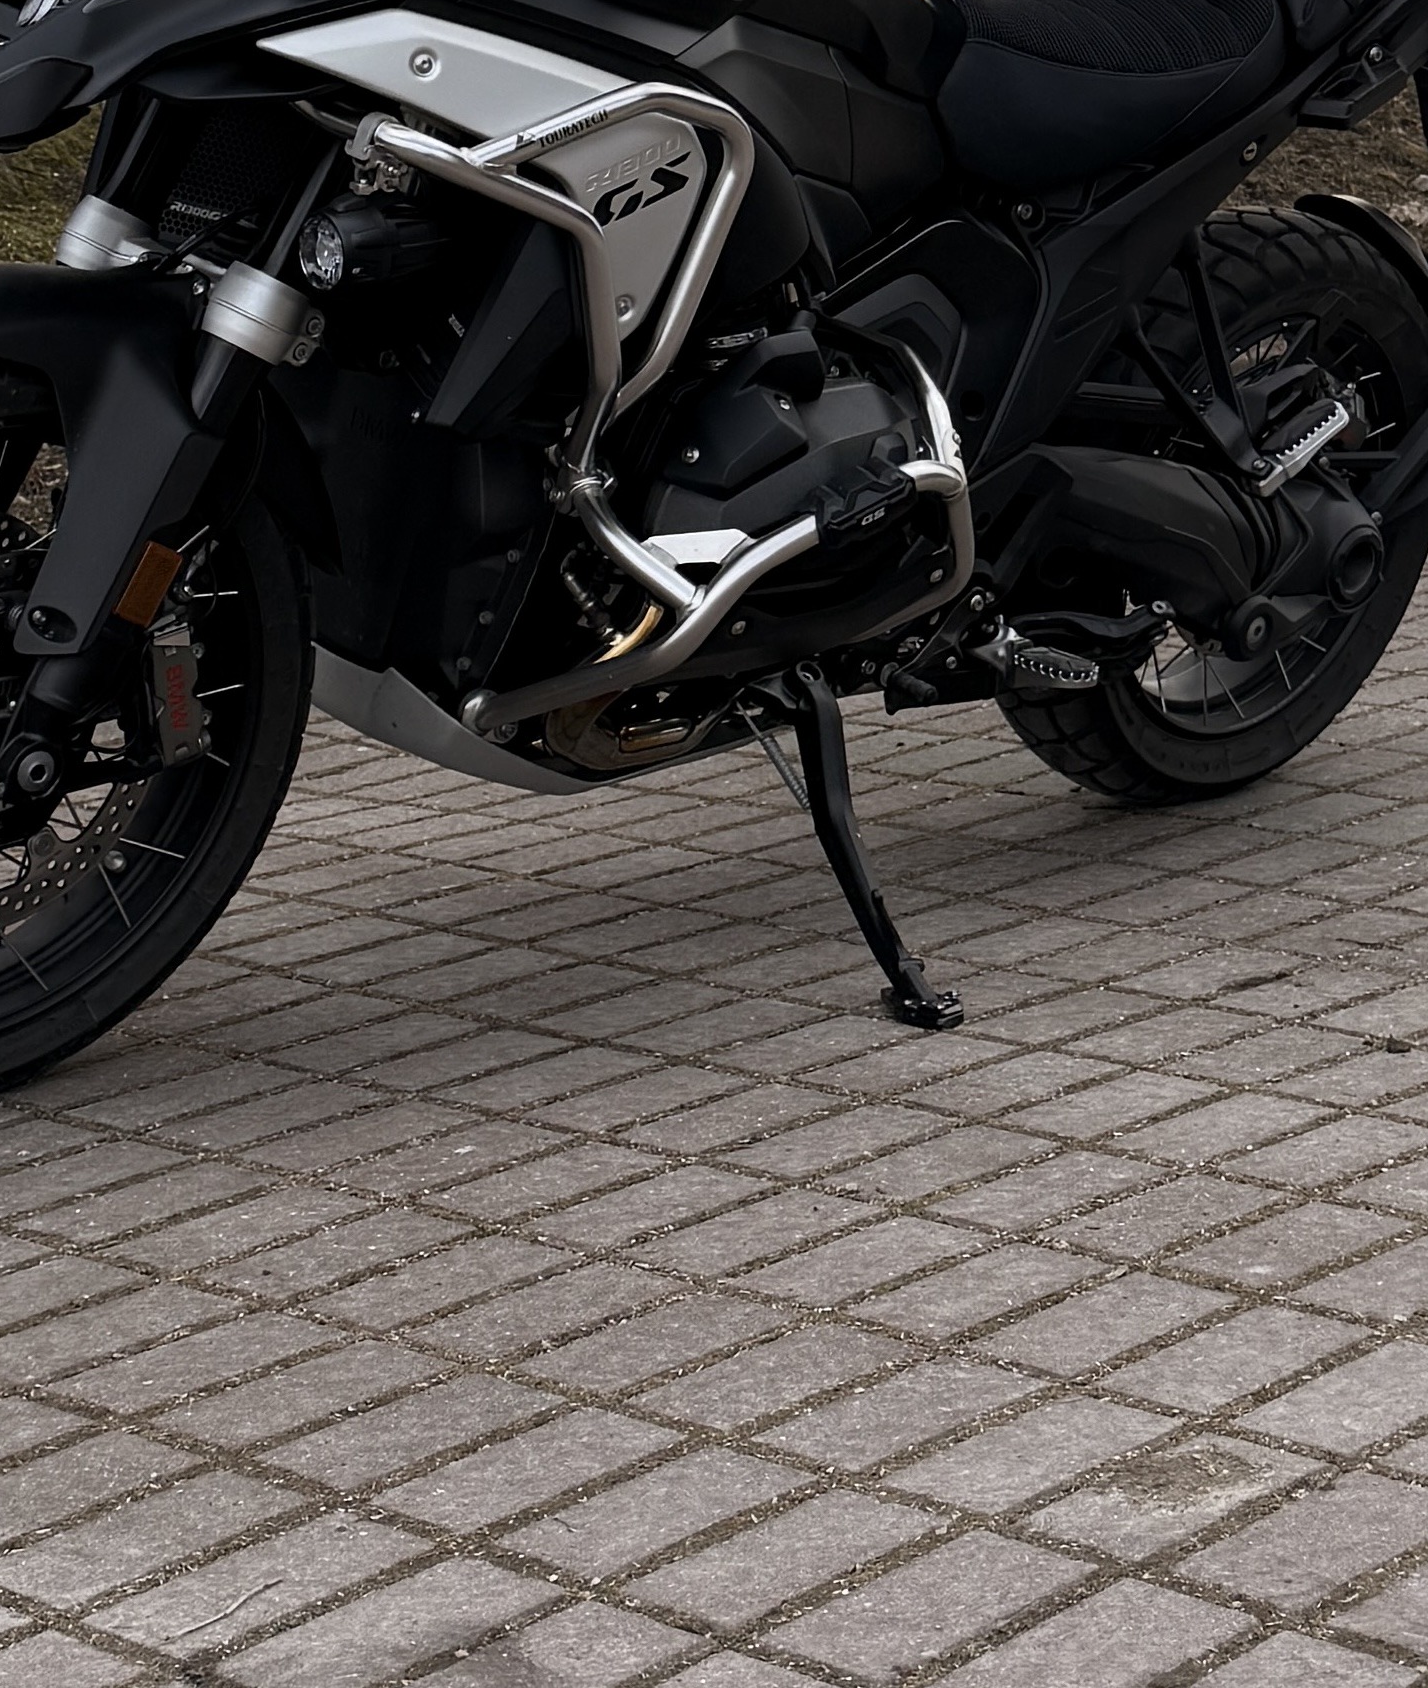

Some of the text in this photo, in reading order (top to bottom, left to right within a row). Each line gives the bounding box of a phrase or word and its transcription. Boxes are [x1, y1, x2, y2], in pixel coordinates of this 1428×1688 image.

[538, 109, 609, 148] TOURATECH
[585, 135, 681, 192] R1300
[170, 201, 228, 220] R1300G
[593, 151, 691, 226] GS
